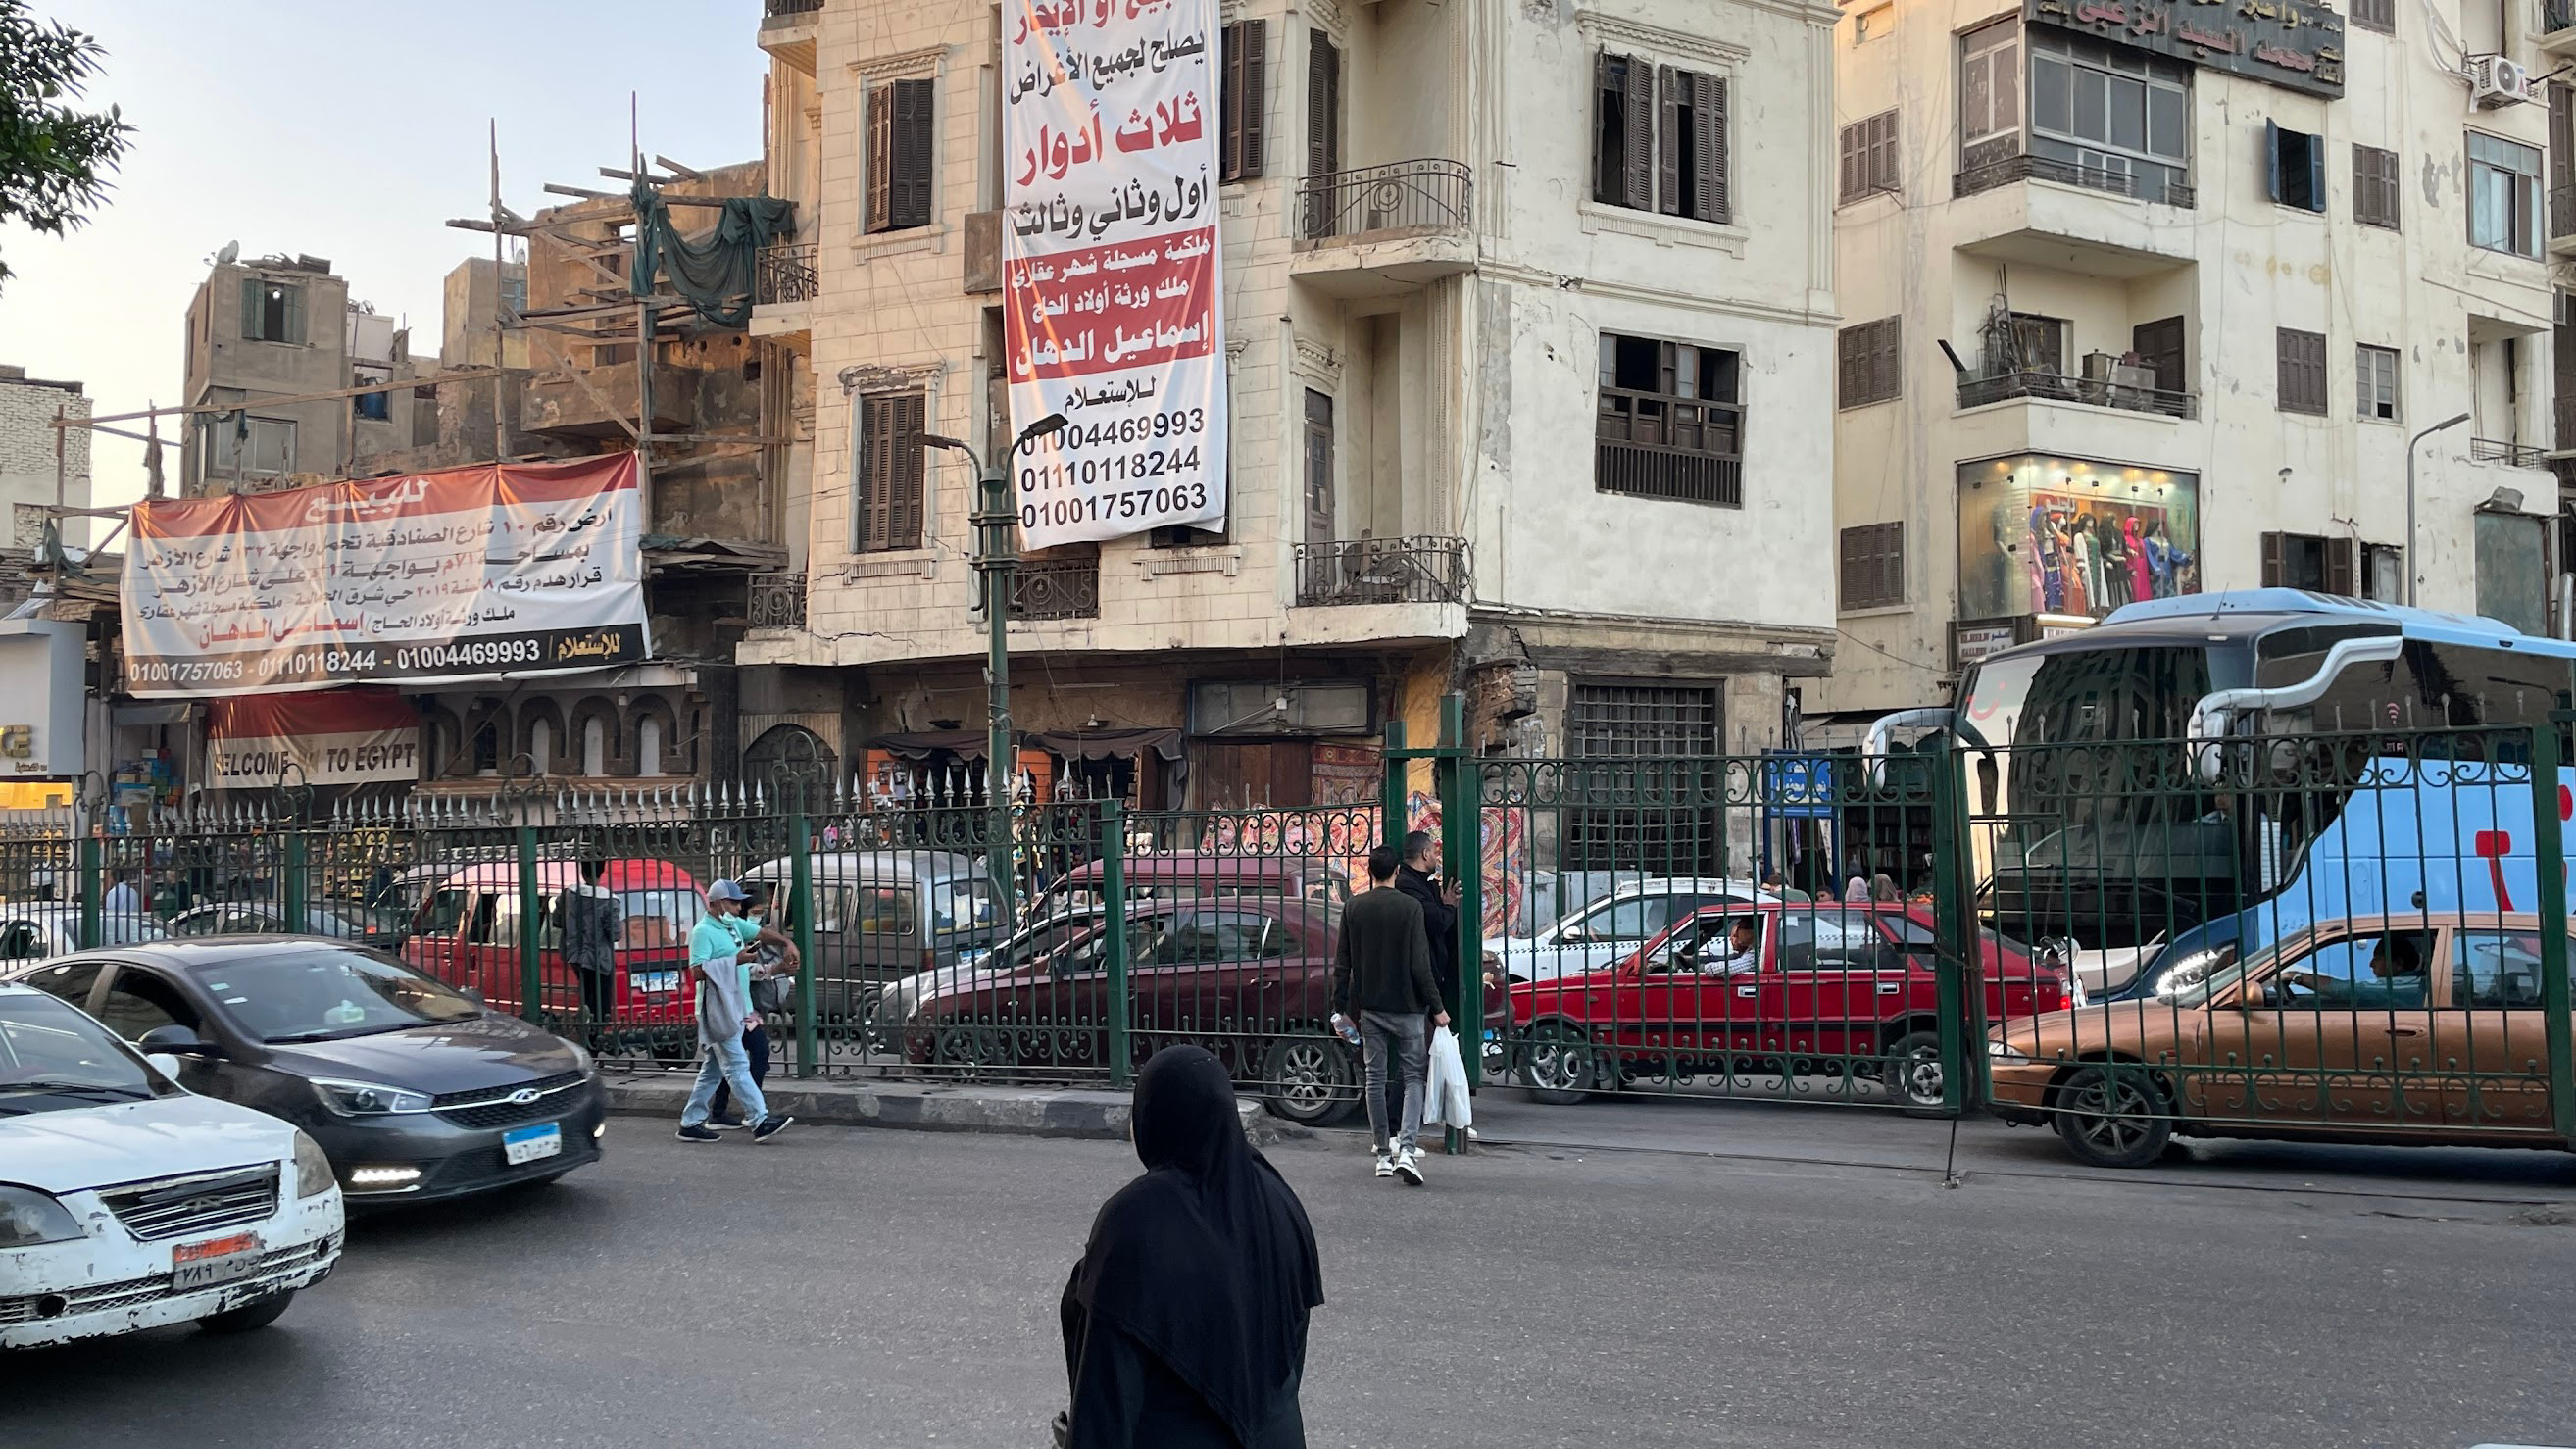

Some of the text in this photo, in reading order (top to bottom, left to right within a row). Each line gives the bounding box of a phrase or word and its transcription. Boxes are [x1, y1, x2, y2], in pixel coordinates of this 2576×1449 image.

[1093, 36, 1145, 90] لجميع
[1151, 28, 1205, 73] يصلح
[1016, 90, 1203, 186] ثلاث أدوار
[1013, 164, 1207, 242] أول وثاني وثالث
[1103, 248, 1158, 273] مسجلة
[1164, 235, 1211, 261] ملكية
[1059, 255, 1097, 283] شهر
[1032, 276, 1189, 323] ملك ورثة أولاد الحاج
[1016, 310, 1208, 375] إسماعيل الدهان
[1020, 407, 1204, 456] 01004469993
[1020, 445, 1200, 492] 01110118244
[1022, 482, 1206, 529] 01001757063
[455, 518, 495, 545] شارع
[532, 512, 566, 536] رقم
[498, 575, 531, 596] رقم
[569, 566, 603, 589] قرار
[481, 606, 516, 623] ملك
[258, 650, 376, 677] 01110118244
[397, 639, 540, 670] 01004469993
[129, 660, 243, 682] 01001757063
[327, 748, 350, 772] TO
[355, 743, 416, 771] EGYPT
